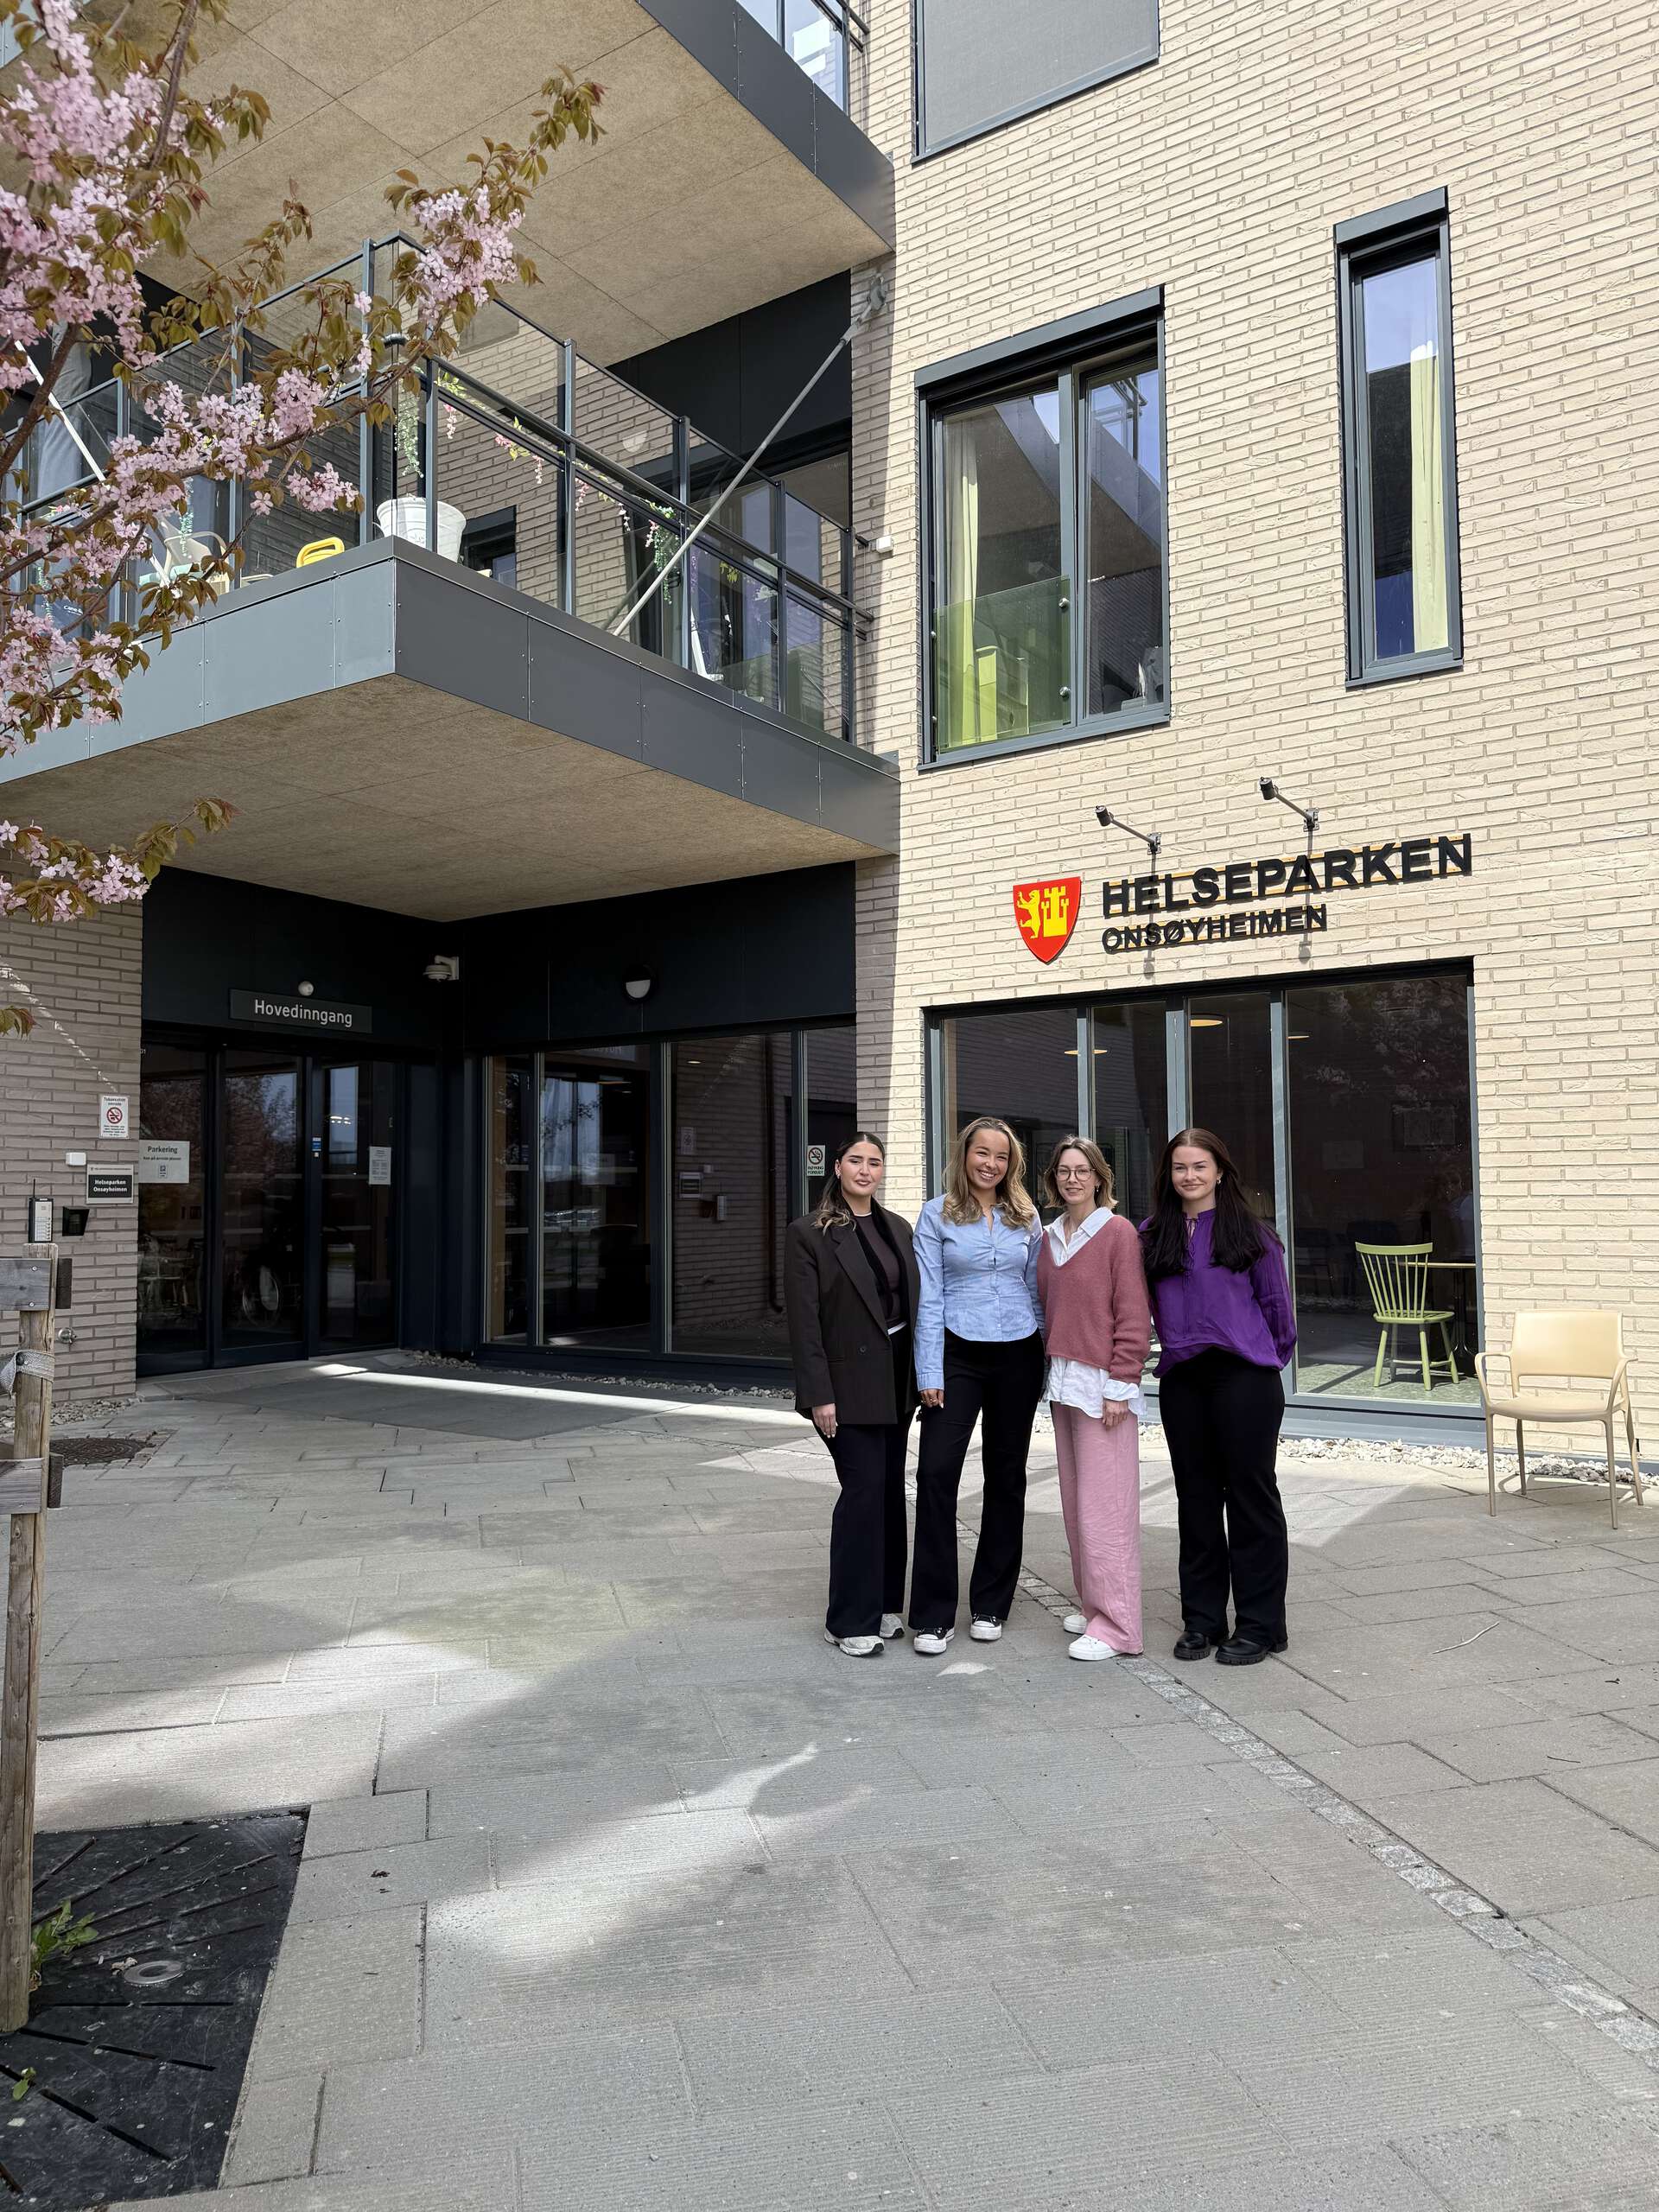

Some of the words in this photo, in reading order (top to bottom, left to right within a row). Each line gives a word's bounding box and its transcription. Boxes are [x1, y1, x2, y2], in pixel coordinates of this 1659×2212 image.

[1103, 834, 1471, 918] HELSEPARKEN
[1102, 904, 1327, 952] ONSØYHEIMEN
[254, 999, 353, 1027] Hovedinngang
[147, 1146, 178, 1154] Parkering
